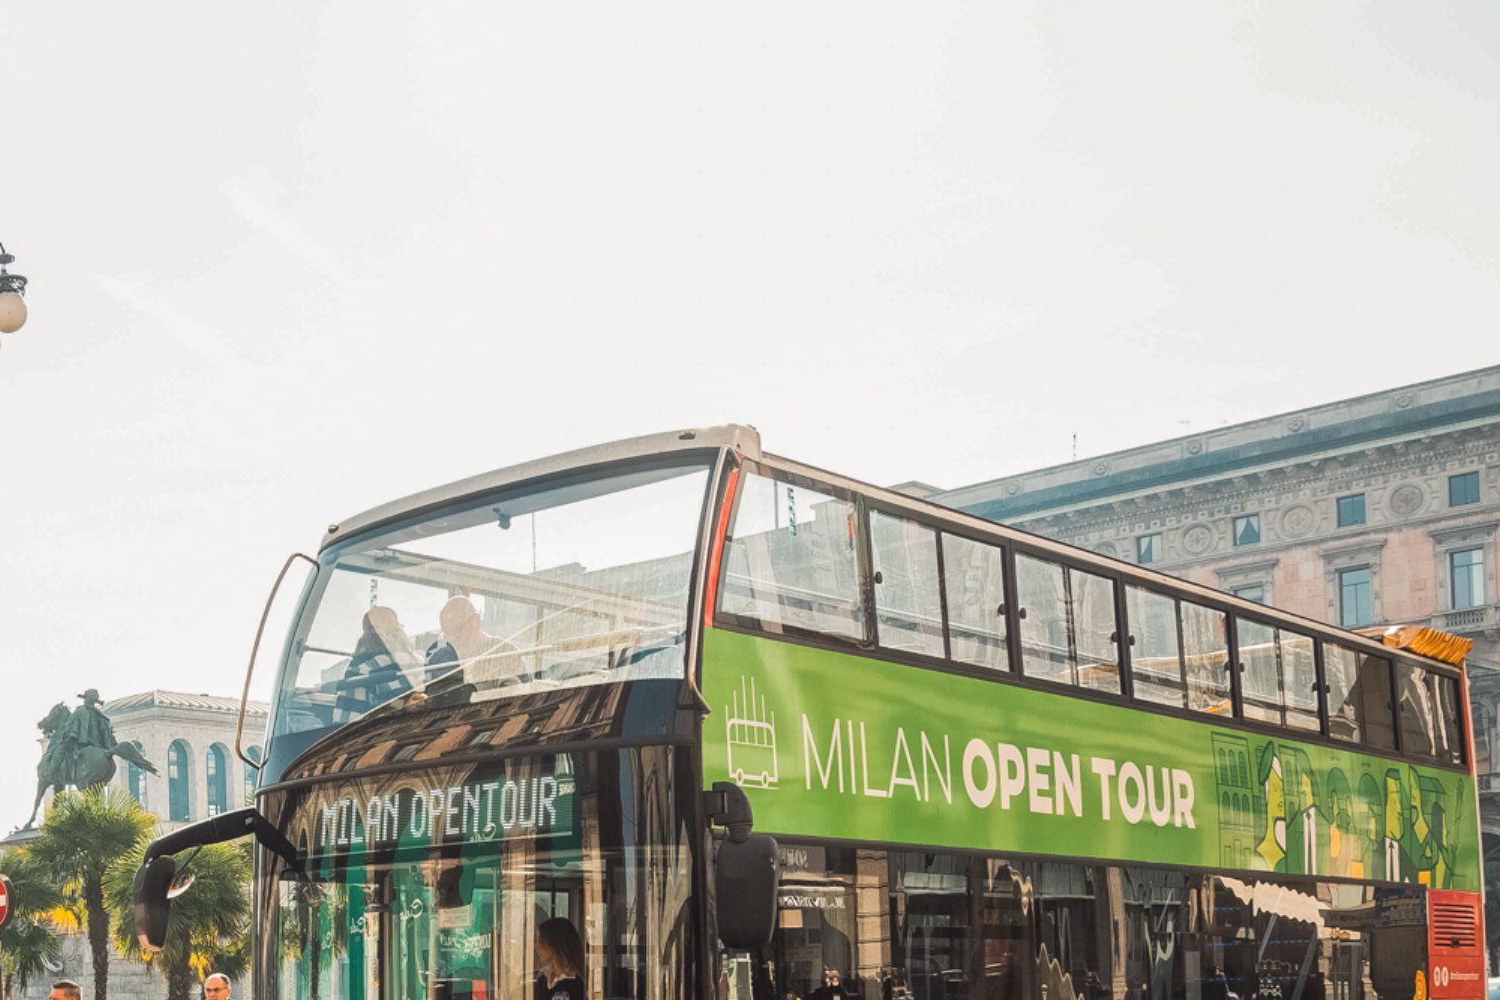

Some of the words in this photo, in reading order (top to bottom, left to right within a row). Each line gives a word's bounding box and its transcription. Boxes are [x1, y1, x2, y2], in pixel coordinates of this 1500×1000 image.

[801, 713, 953, 804] MILAN
[962, 737, 1083, 817] OPEN
[1091, 756, 1196, 829] TOUR
[320, 793, 399, 847] MILAN
